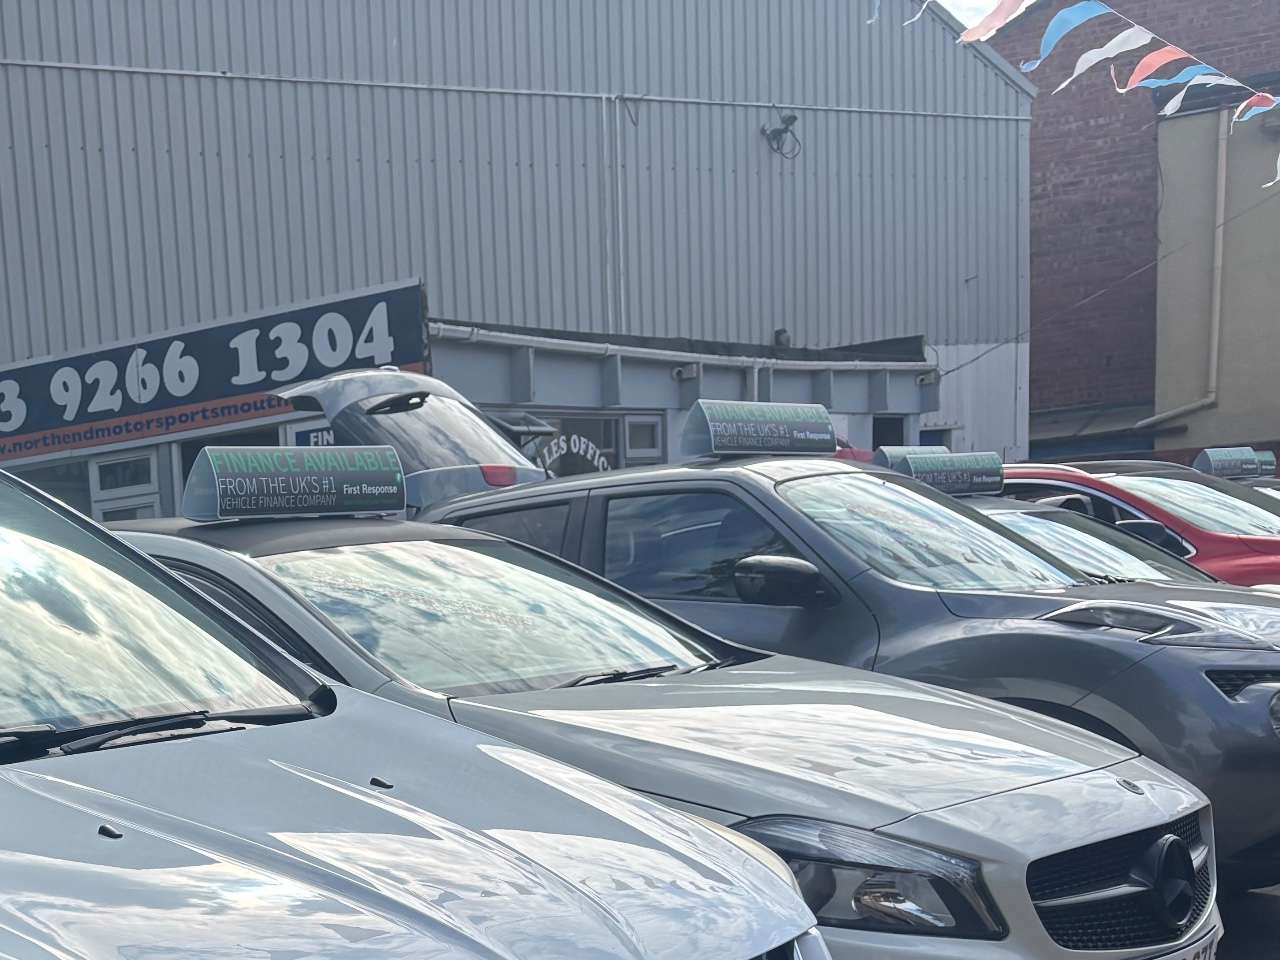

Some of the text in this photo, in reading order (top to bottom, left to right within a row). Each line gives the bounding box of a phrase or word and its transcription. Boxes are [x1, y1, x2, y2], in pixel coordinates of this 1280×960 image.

[50, 340, 199, 421] 9266
[229, 301, 395, 386] 1304
[211, 451, 399, 473] FINANCE AVAILABLE
[570, 434, 612, 472] OFFIC
[219, 476, 337, 495] FROM THE UK'S #1
[343, 483, 397, 496] First Response
[220, 494, 337, 510] VEHICLE FINANCE COMPANY
